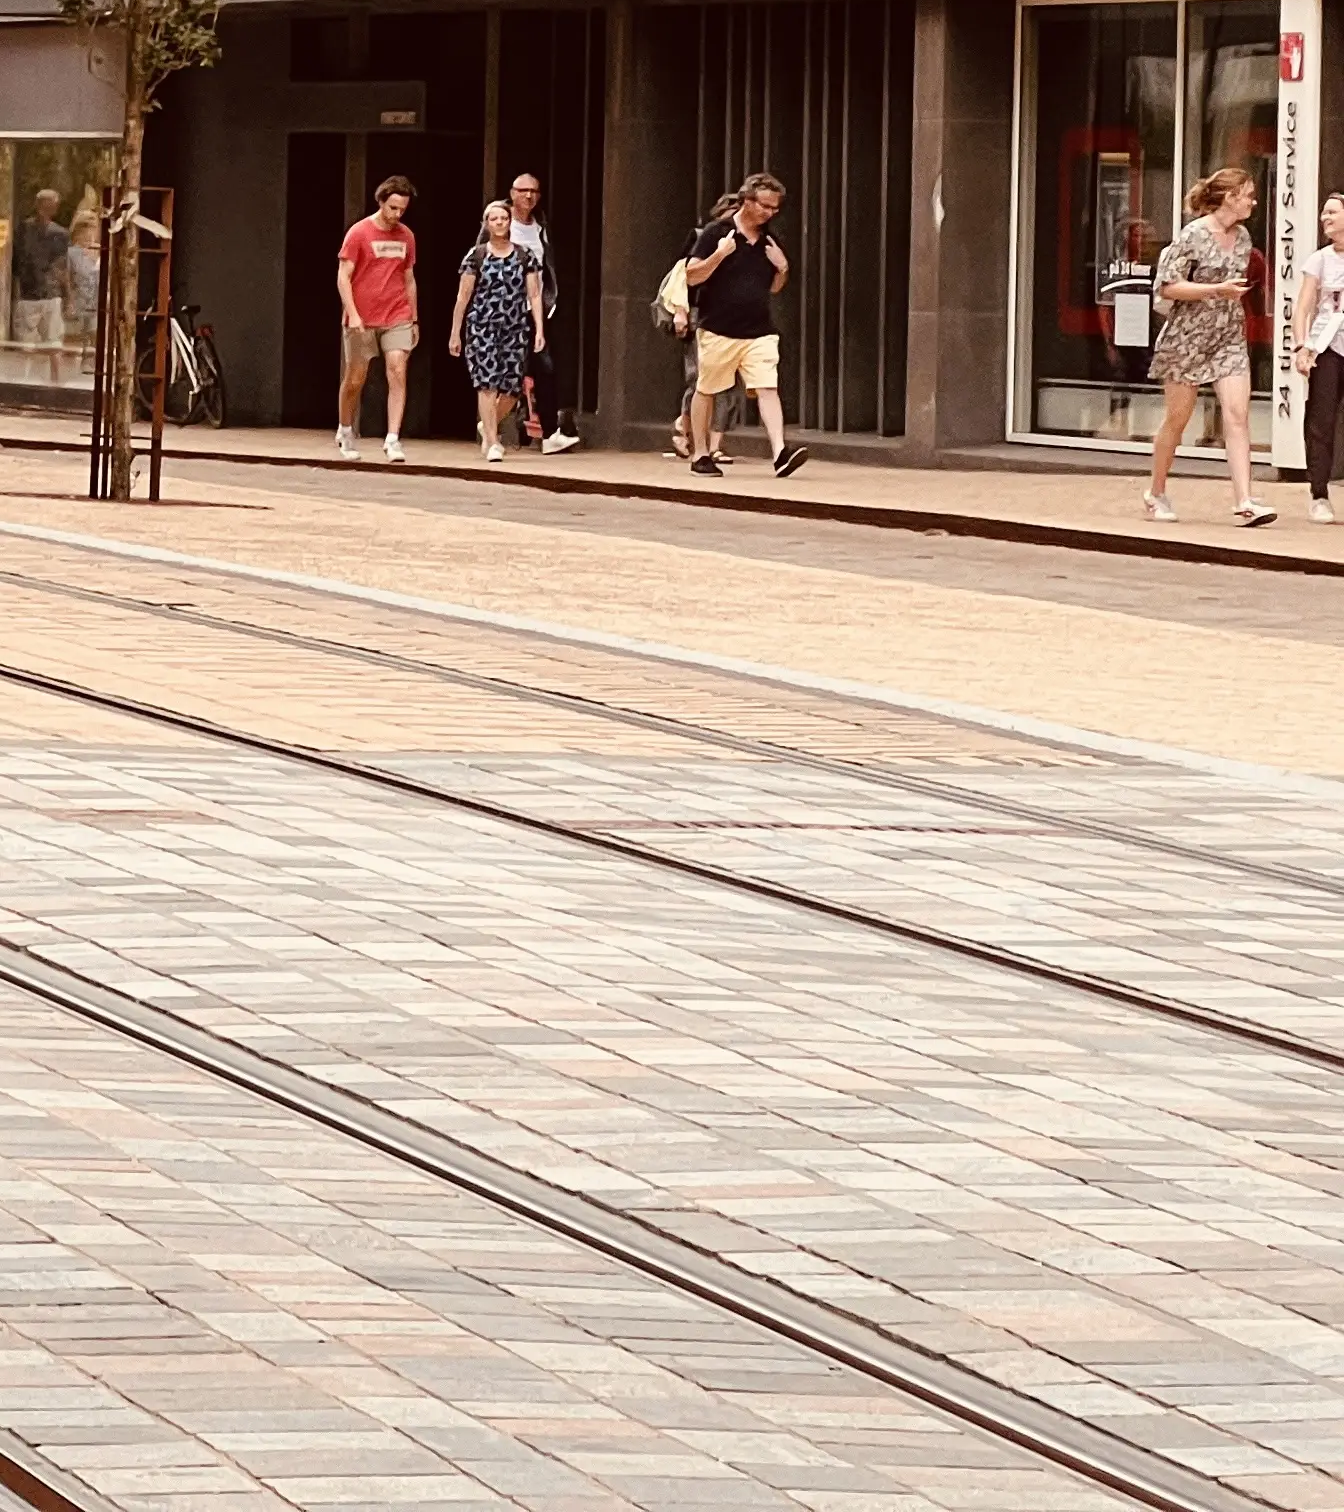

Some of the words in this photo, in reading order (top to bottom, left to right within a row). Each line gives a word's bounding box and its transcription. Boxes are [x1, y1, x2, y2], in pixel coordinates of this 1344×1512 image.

[1281, 101, 1298, 208] Service
[1280, 219, 1295, 281] Selv
[1278, 292, 1293, 372] timer
[1278, 384, 1292, 420] 24
